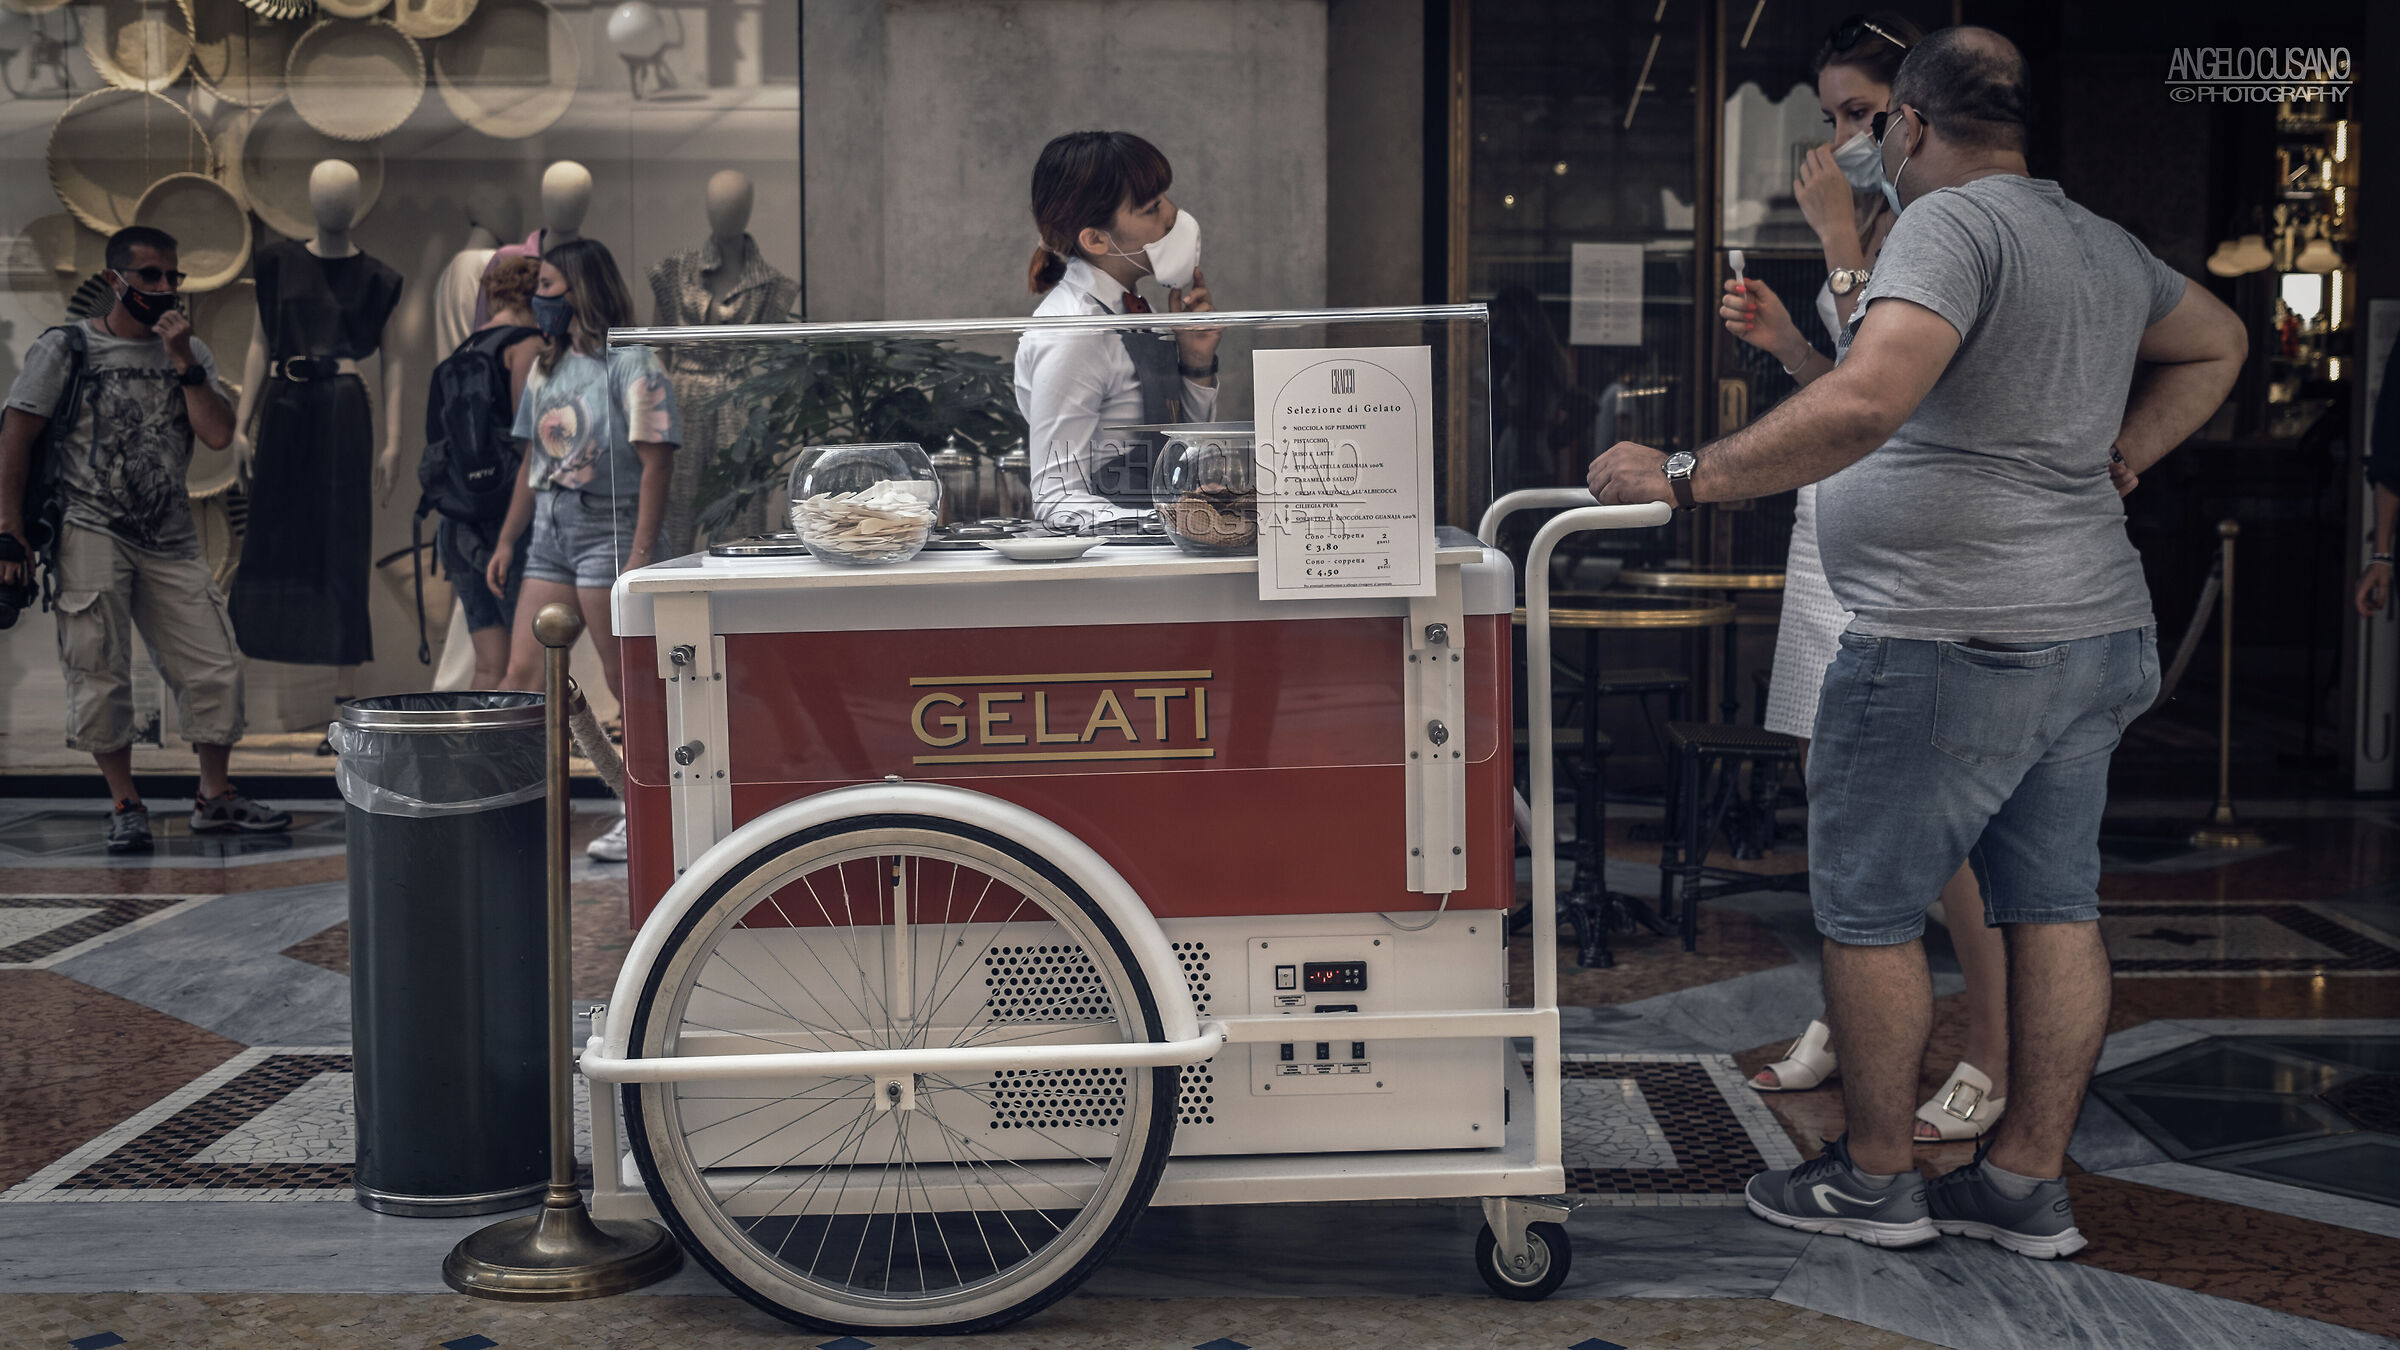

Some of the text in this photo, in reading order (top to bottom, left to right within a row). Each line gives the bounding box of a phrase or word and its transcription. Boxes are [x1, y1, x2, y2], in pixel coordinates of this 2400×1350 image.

[1287, 404, 1401, 415] Selezione di Gelato
[1305, 543, 1312, 551] €
[911, 687, 1207, 748] GELATI
